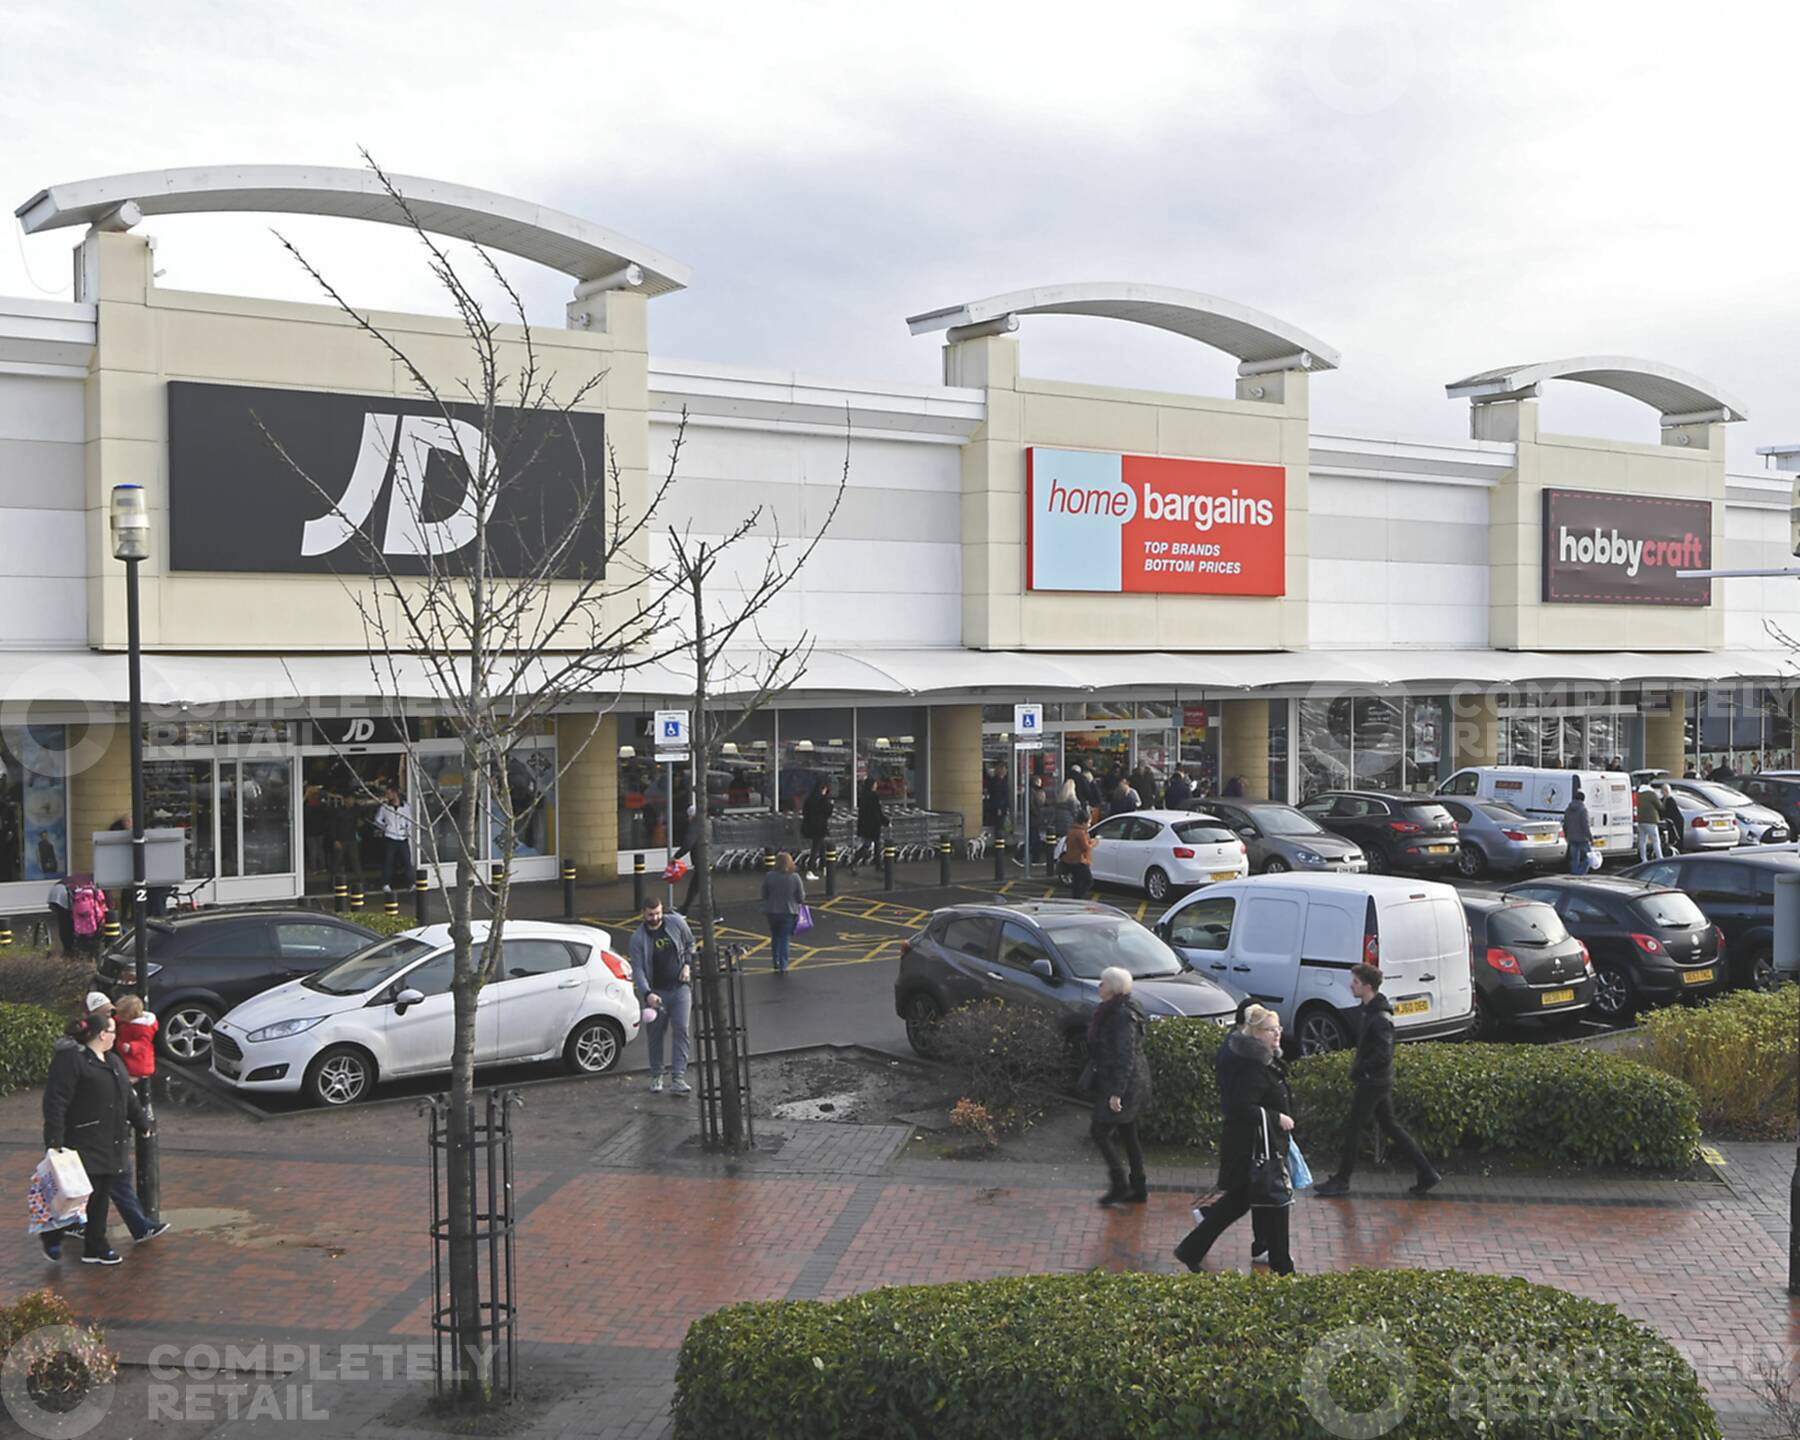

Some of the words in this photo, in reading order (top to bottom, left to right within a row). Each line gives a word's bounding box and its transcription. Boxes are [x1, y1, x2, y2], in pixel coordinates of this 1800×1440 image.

[301, 411, 499, 557] JD
[1048, 479, 1129, 518] home
[1143, 482, 1274, 531] bargains
[1144, 541, 1168, 554] TOP
[1171, 542, 1221, 557] BRANDS
[1144, 558, 1195, 572] BOTTOM
[1198, 560, 1241, 574] PRICES
[1559, 525, 1702, 577] hobbycraft
[341, 718, 375, 742] JD
